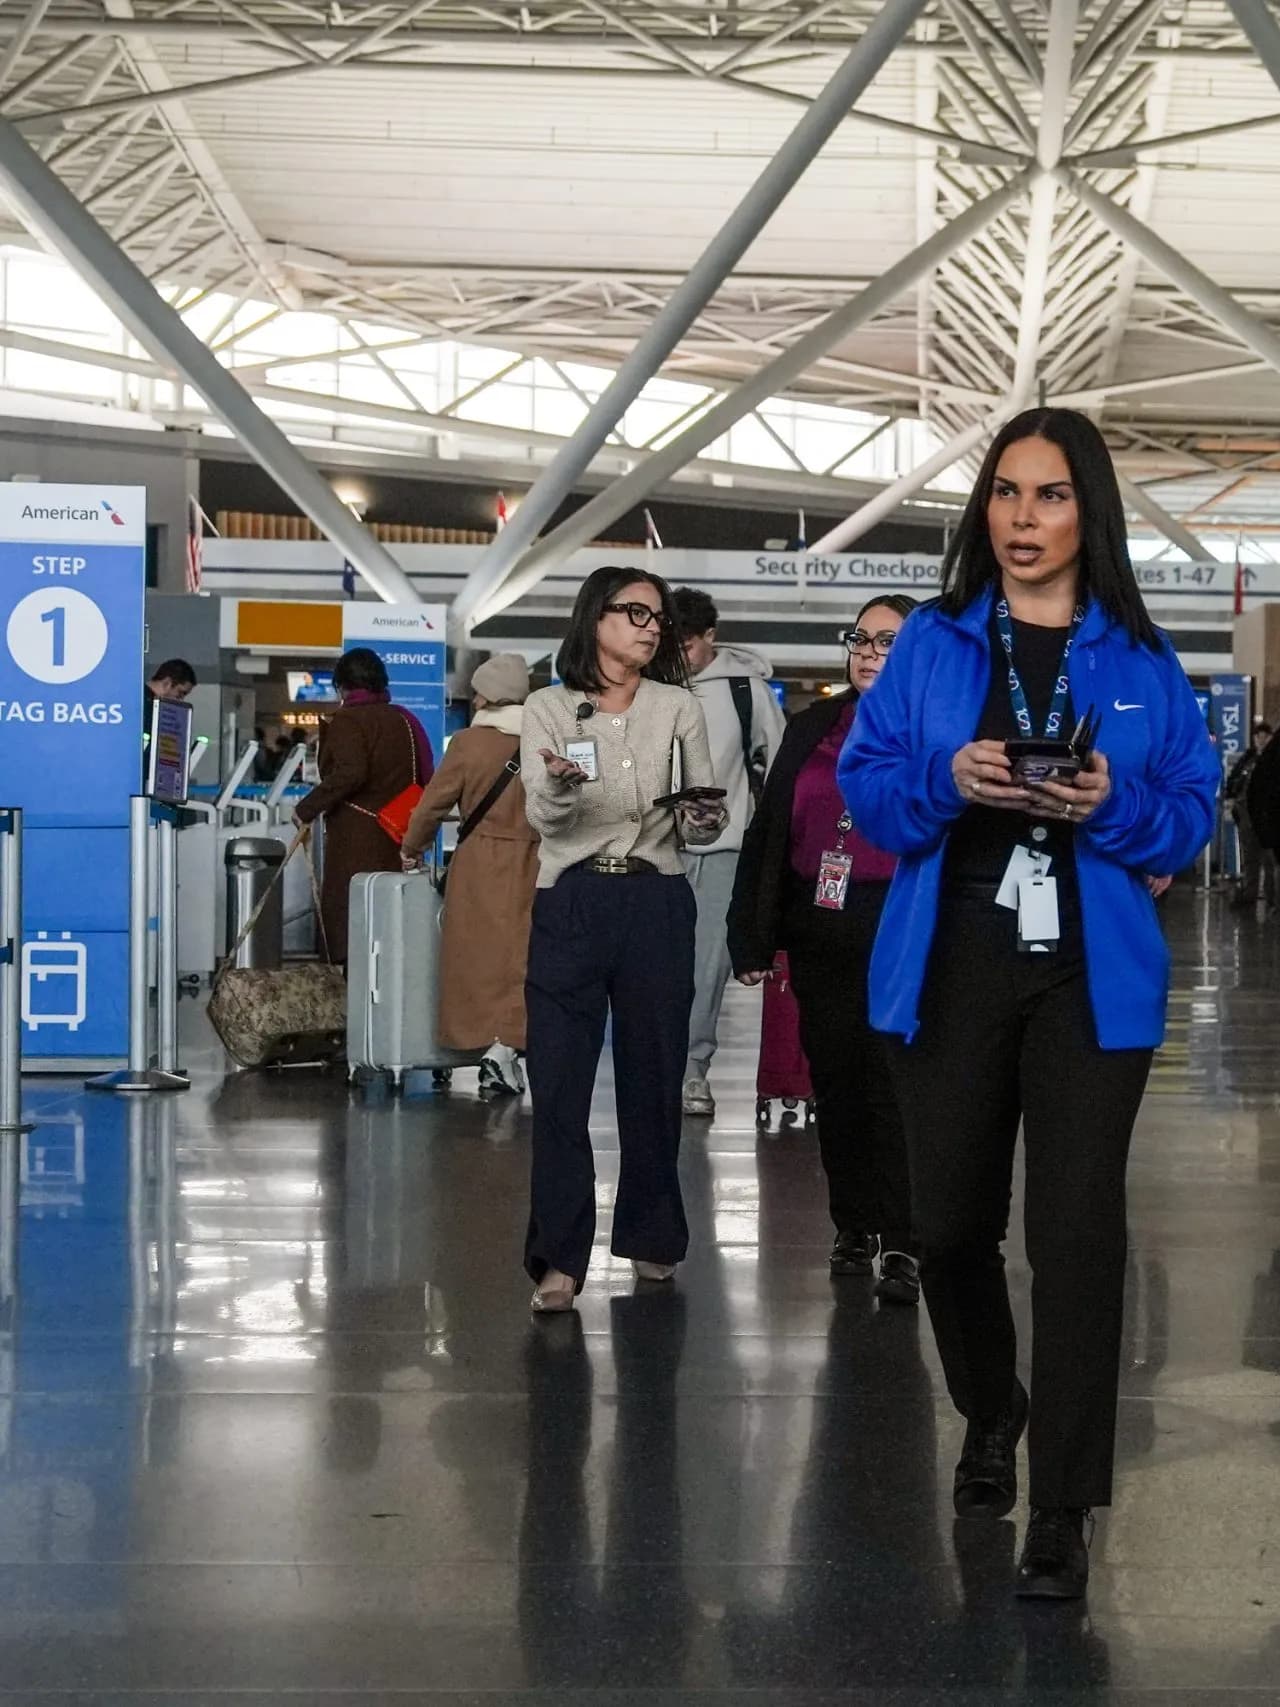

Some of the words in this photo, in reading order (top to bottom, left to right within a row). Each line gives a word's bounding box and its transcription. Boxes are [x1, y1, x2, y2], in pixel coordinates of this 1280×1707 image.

[21, 505, 99, 521] American
[32, 556, 87, 575] STEP
[849, 558, 939, 582] Checkpo
[1135, 566, 1166, 584] tes
[1172, 566, 1217, 585] 1-47
[371, 617, 419, 627] American
[40, 606, 66, 667] 1
[377, 653, 437, 665] -SERVICE
[53, 703, 123, 724] BAGS
